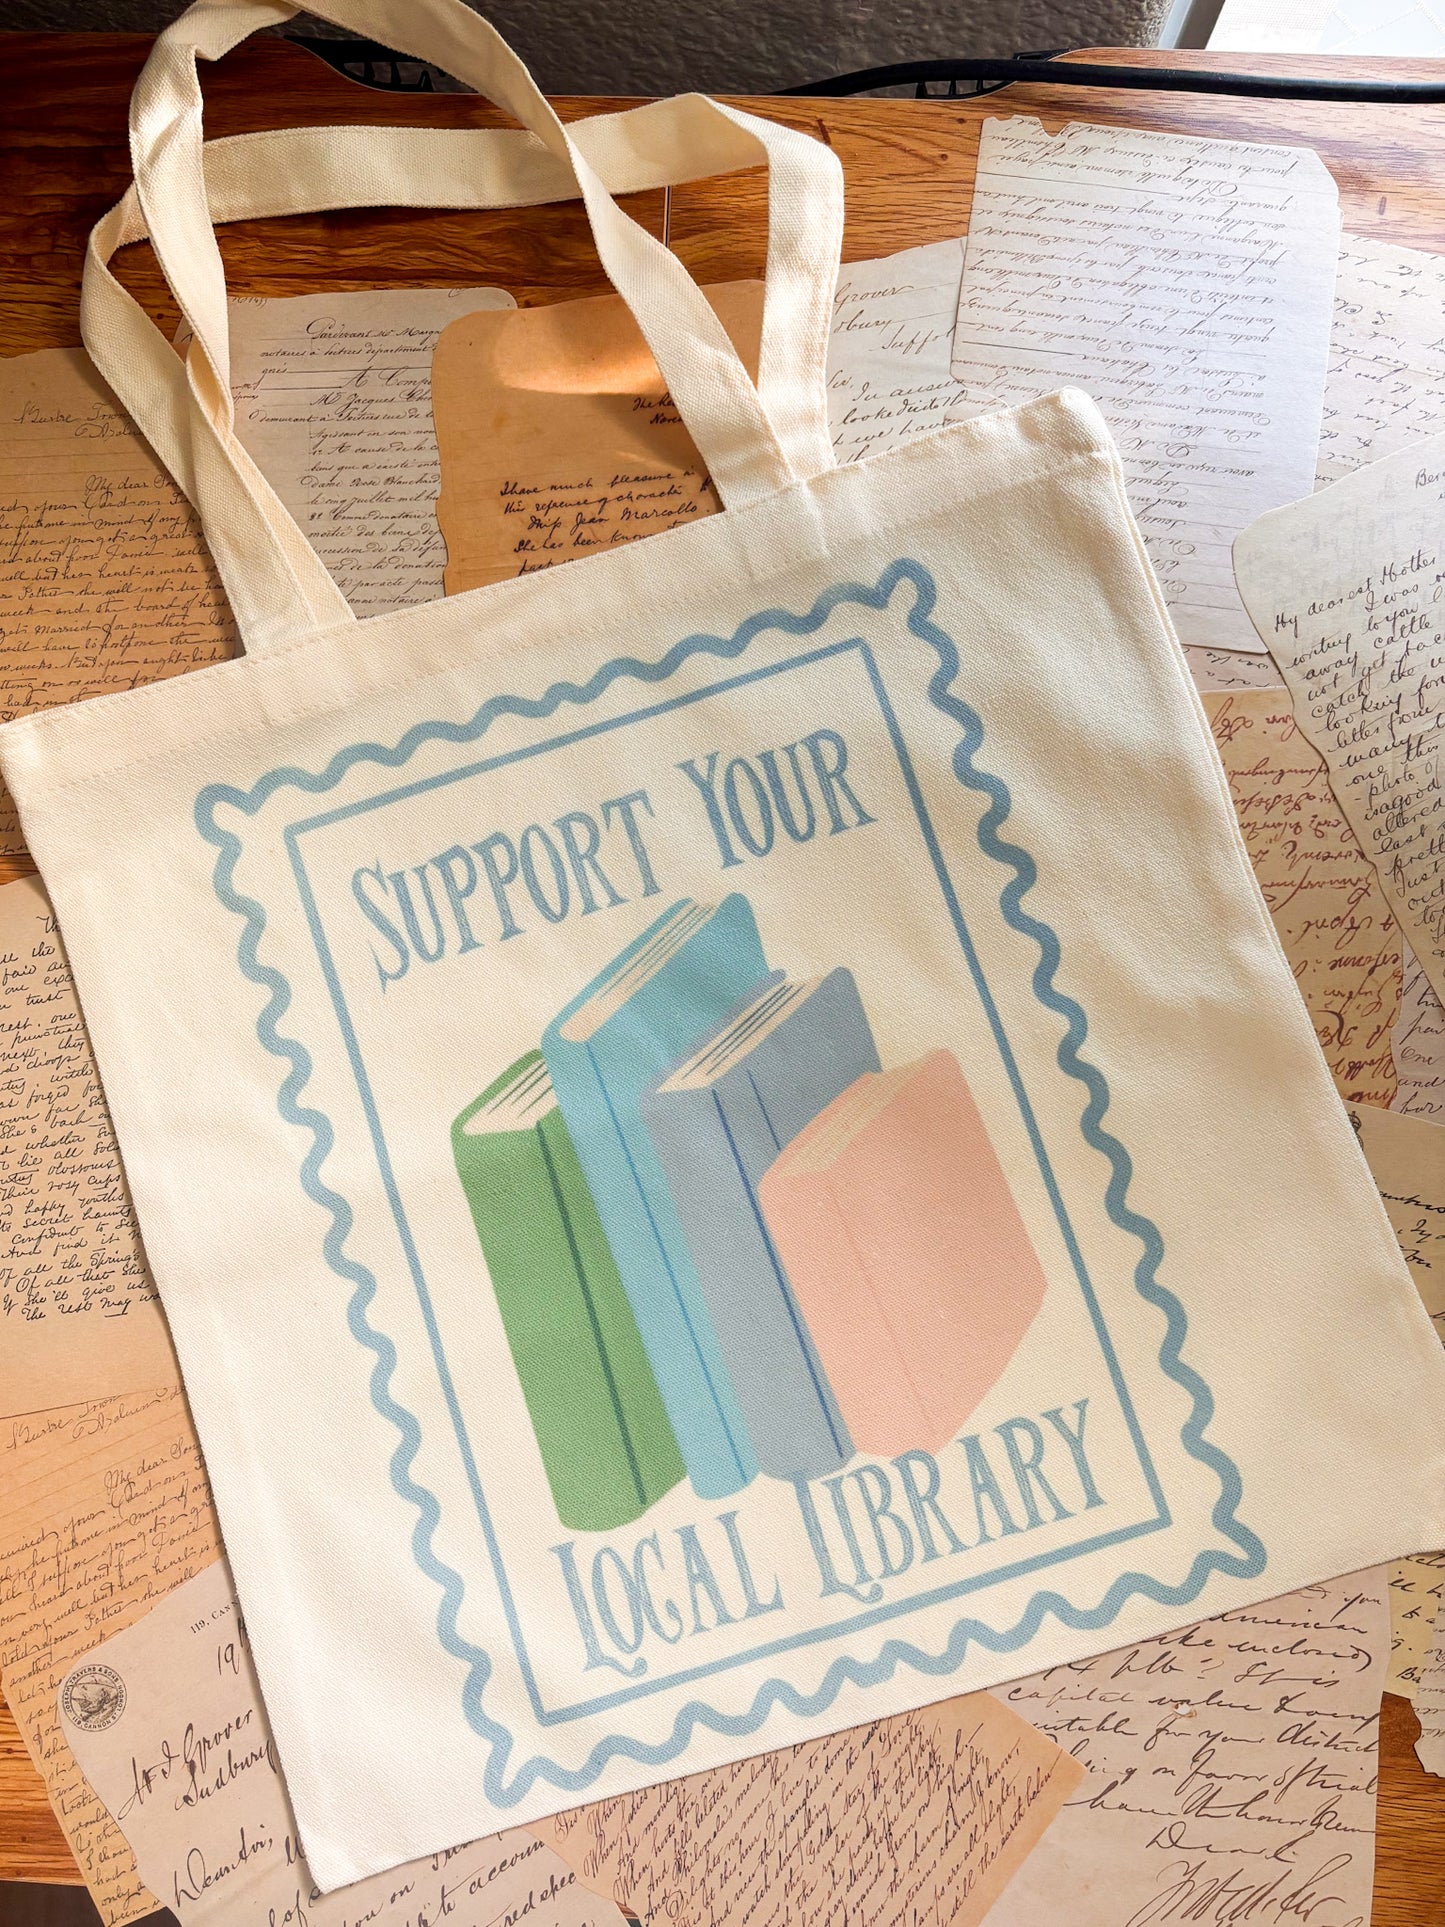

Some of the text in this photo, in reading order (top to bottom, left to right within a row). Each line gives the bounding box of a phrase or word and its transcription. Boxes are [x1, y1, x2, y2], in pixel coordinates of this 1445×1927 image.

[351, 728, 877, 994] SUPPORT YOUR
[547, 1398, 1107, 1678] LOCAL LIBRARY
